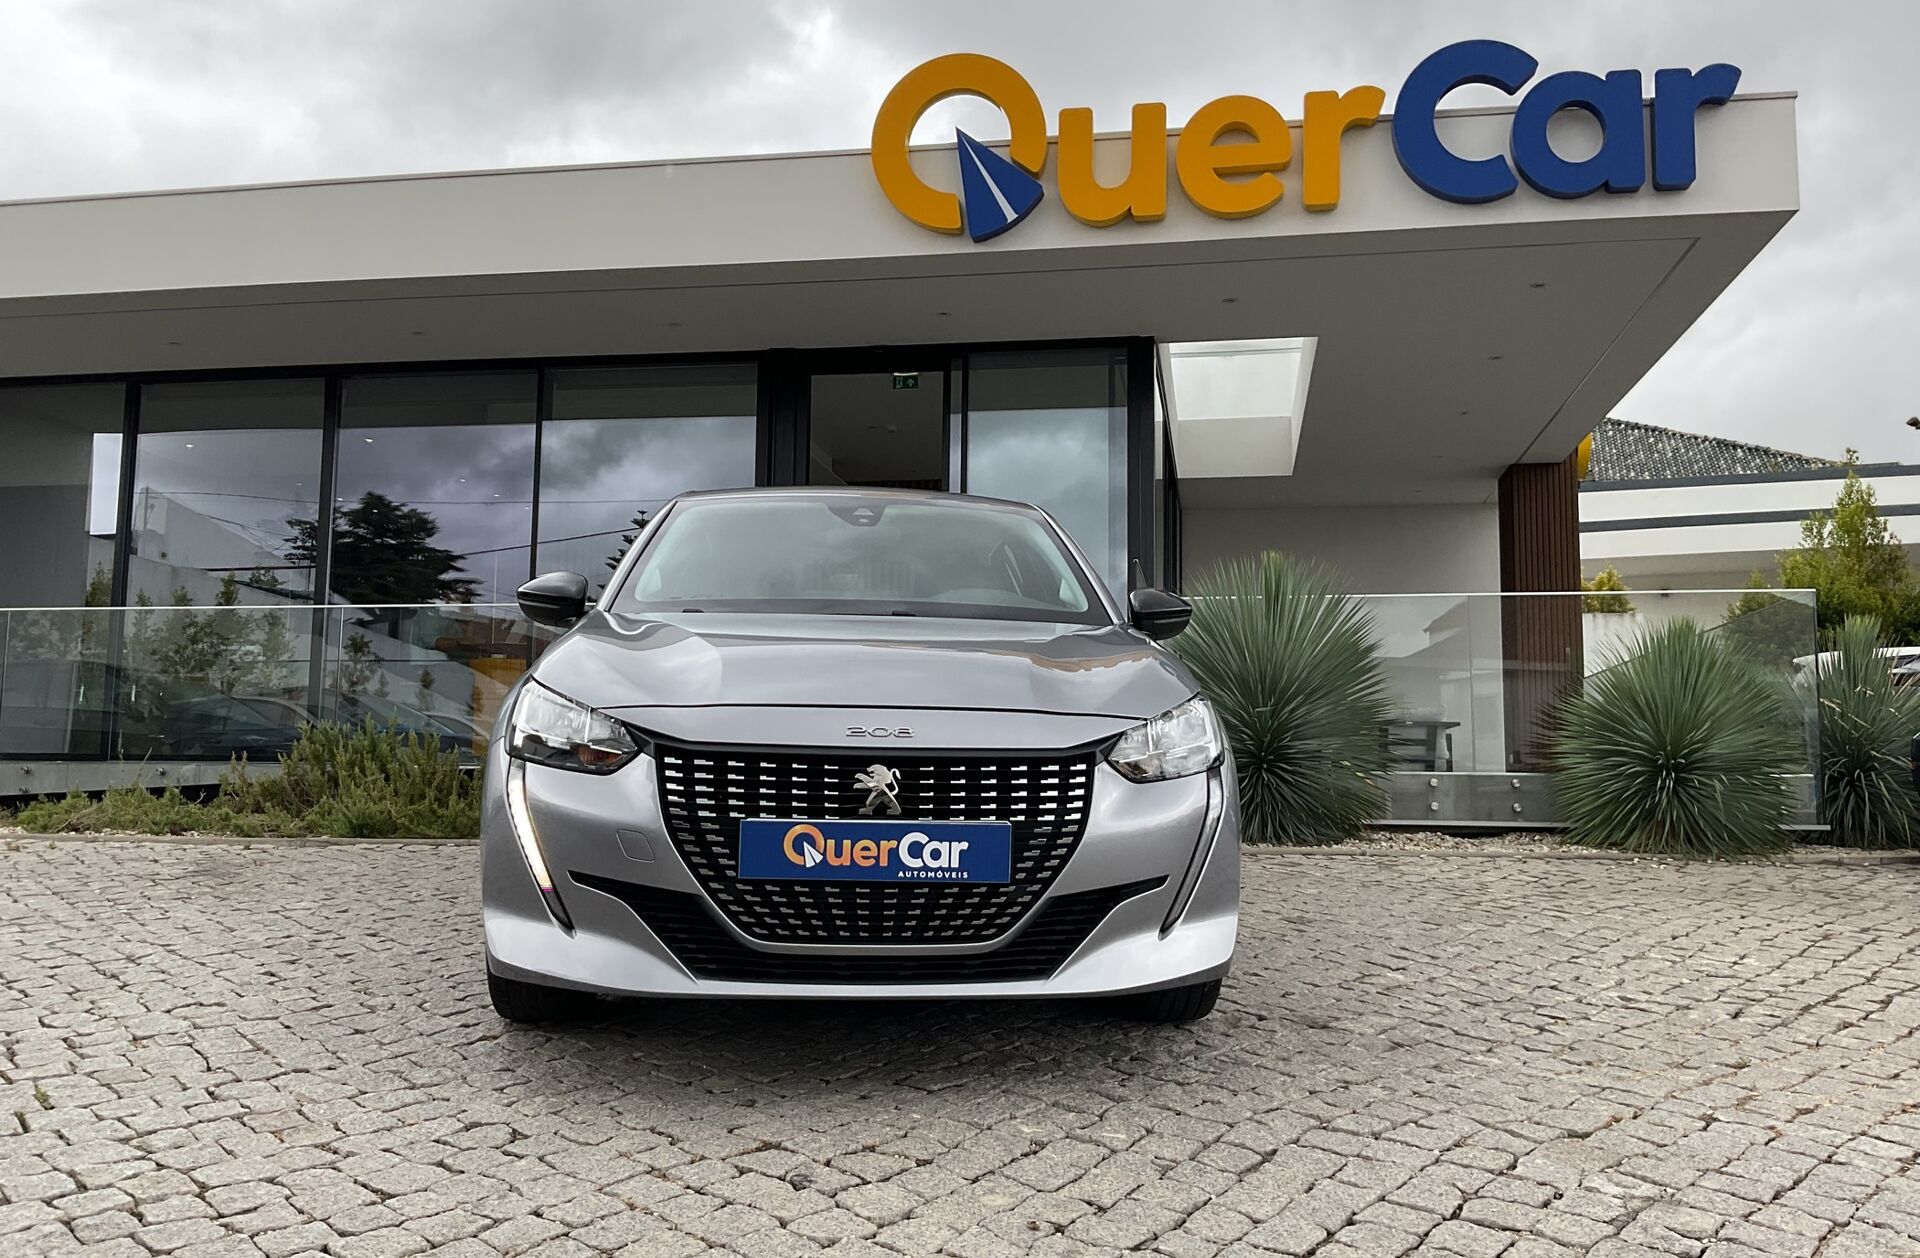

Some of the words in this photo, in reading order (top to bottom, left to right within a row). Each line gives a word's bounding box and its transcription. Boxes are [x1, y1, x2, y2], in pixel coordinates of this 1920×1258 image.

[870, 39, 1742, 242] QuerCar
[845, 725, 914, 738] 208
[783, 823, 969, 868] QuerCar
[897, 869, 969, 879] AUTOMÓVEIS
